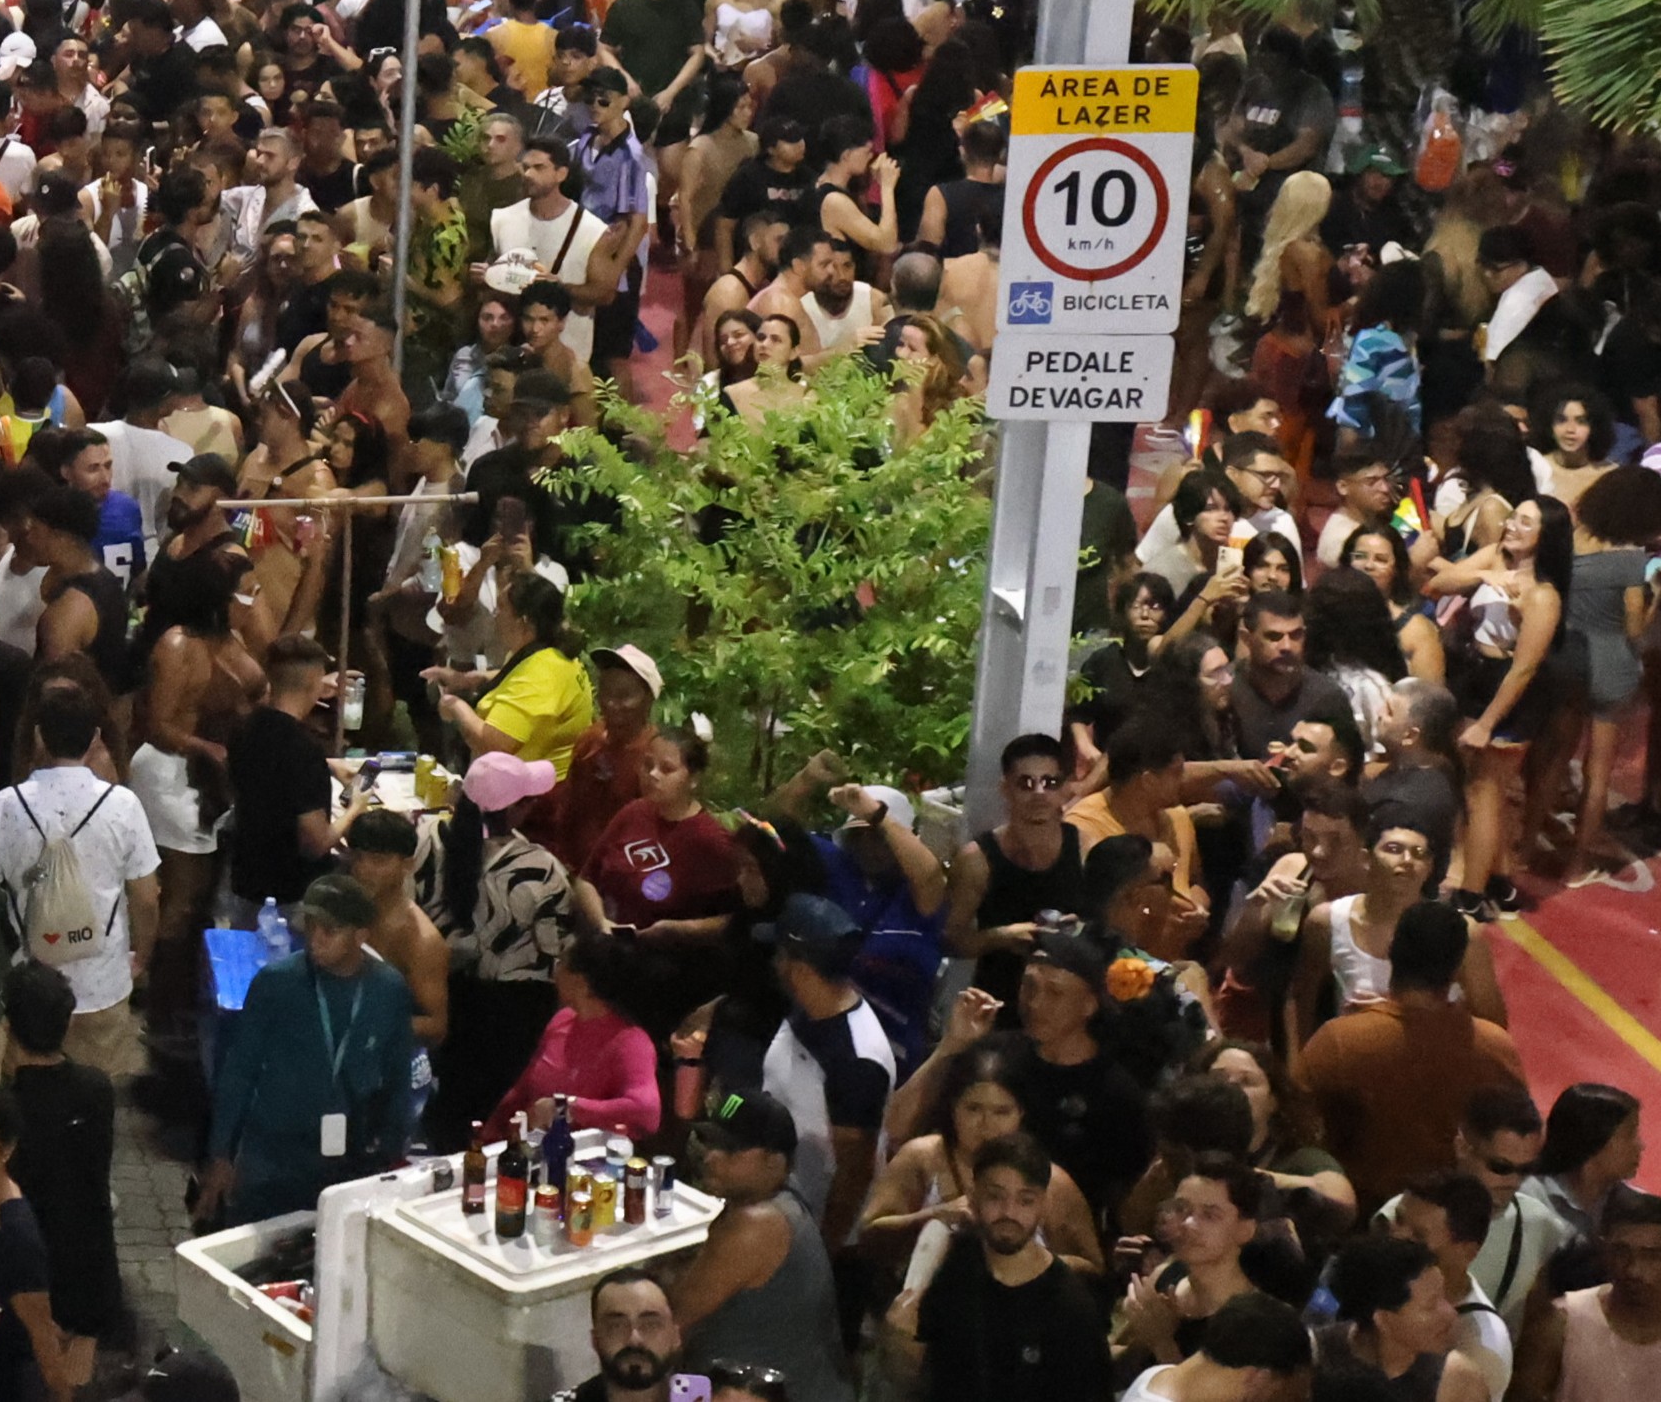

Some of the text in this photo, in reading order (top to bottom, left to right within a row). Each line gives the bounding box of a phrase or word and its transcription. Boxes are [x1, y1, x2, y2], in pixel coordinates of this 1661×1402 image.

[1040, 74, 1170, 98] ÁREA DE
[1057, 105, 1151, 126] LAZER
[1053, 169, 1137, 227] 10
[1068, 238, 1114, 250] km/h
[1063, 294, 1170, 310] BICICLETA
[1026, 351, 1134, 373] PEDALE
[1009, 387, 1144, 409] DEVAGAR
[68, 926, 93, 944] RIO
